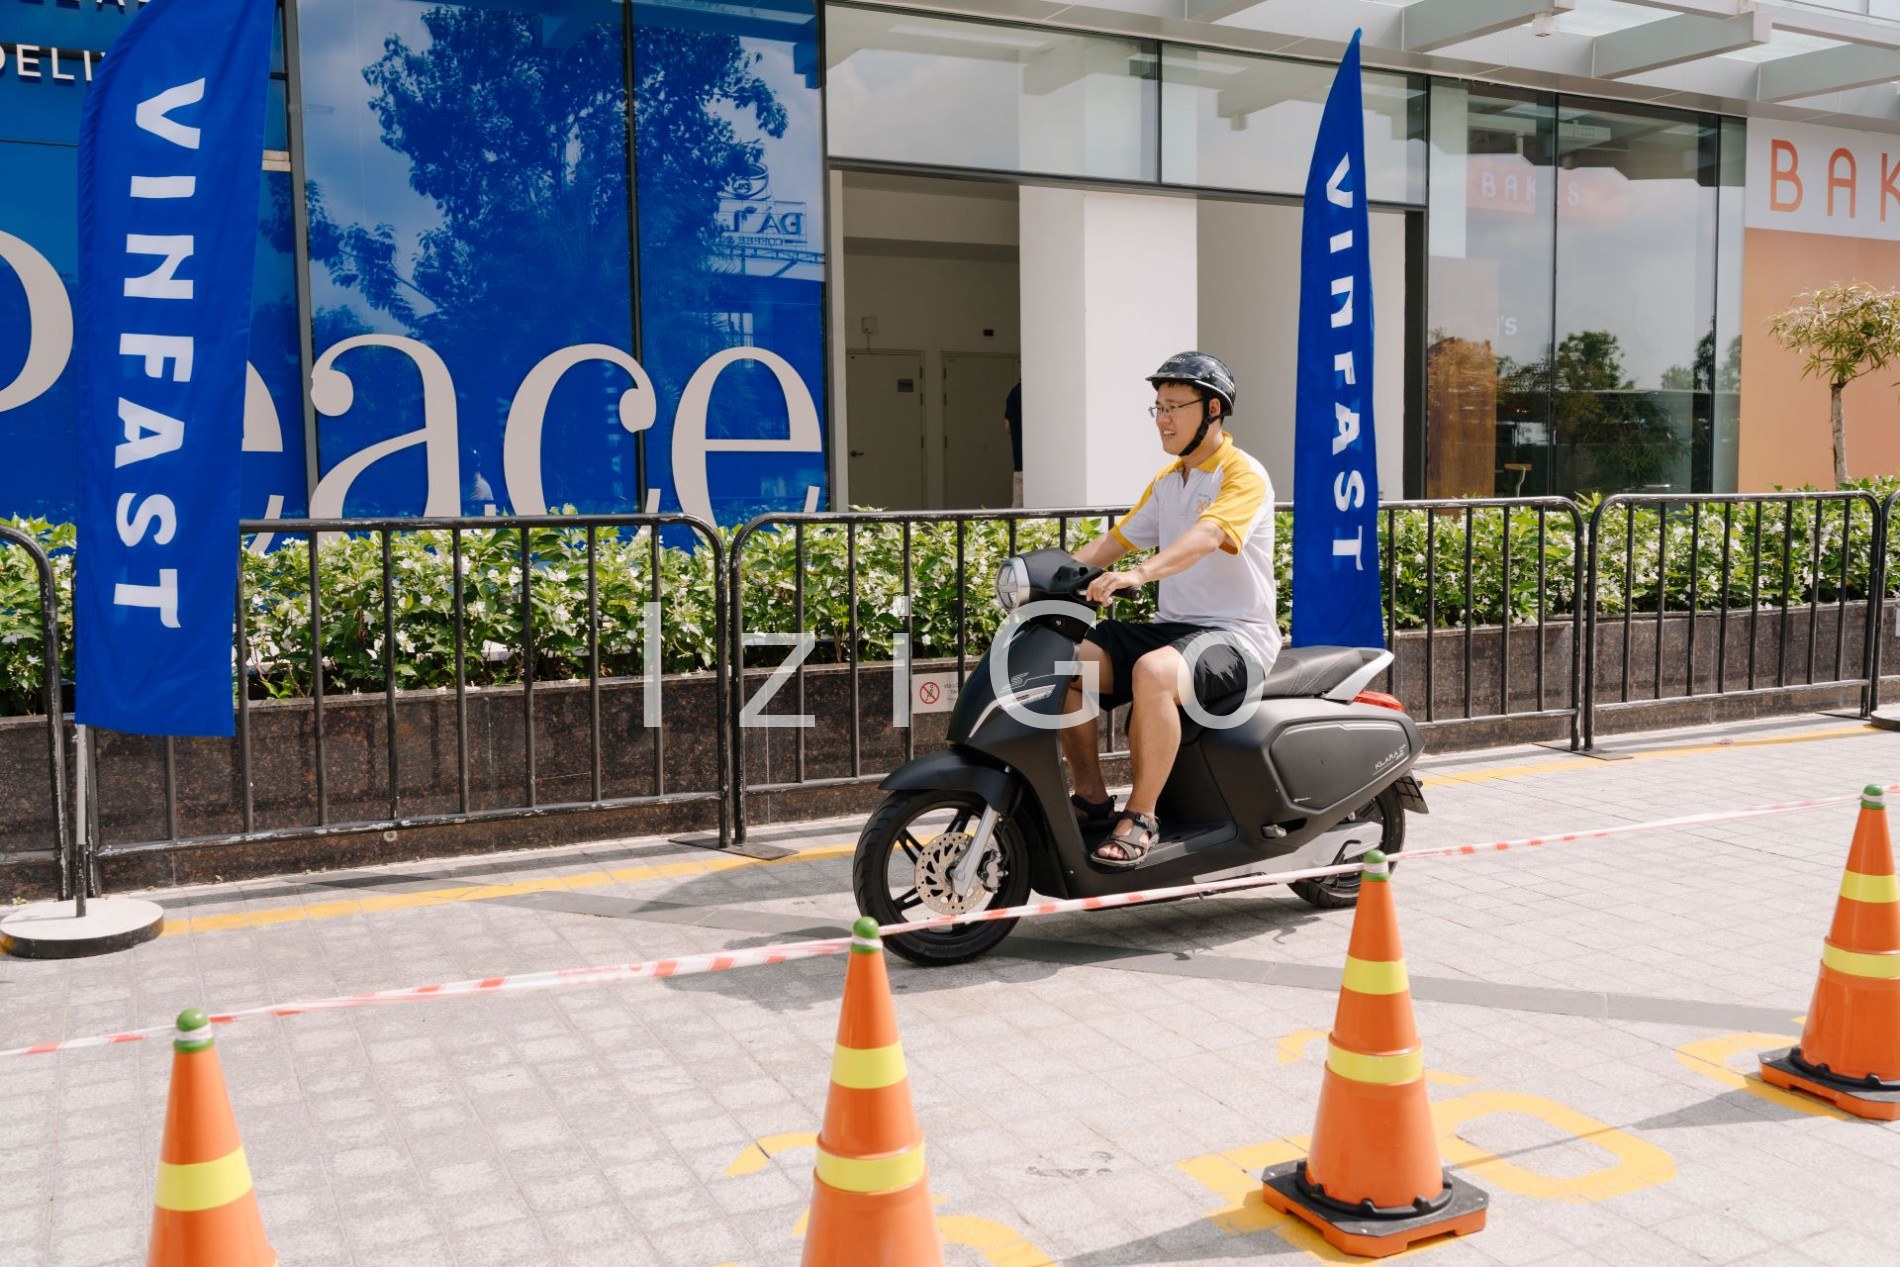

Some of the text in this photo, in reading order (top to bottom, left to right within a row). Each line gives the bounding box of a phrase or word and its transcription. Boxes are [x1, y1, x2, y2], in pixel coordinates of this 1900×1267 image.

[113, 77, 206, 629] VINFAST
[1326, 153, 1365, 571] VINFAST
[1769, 138, 1900, 222] BAK
